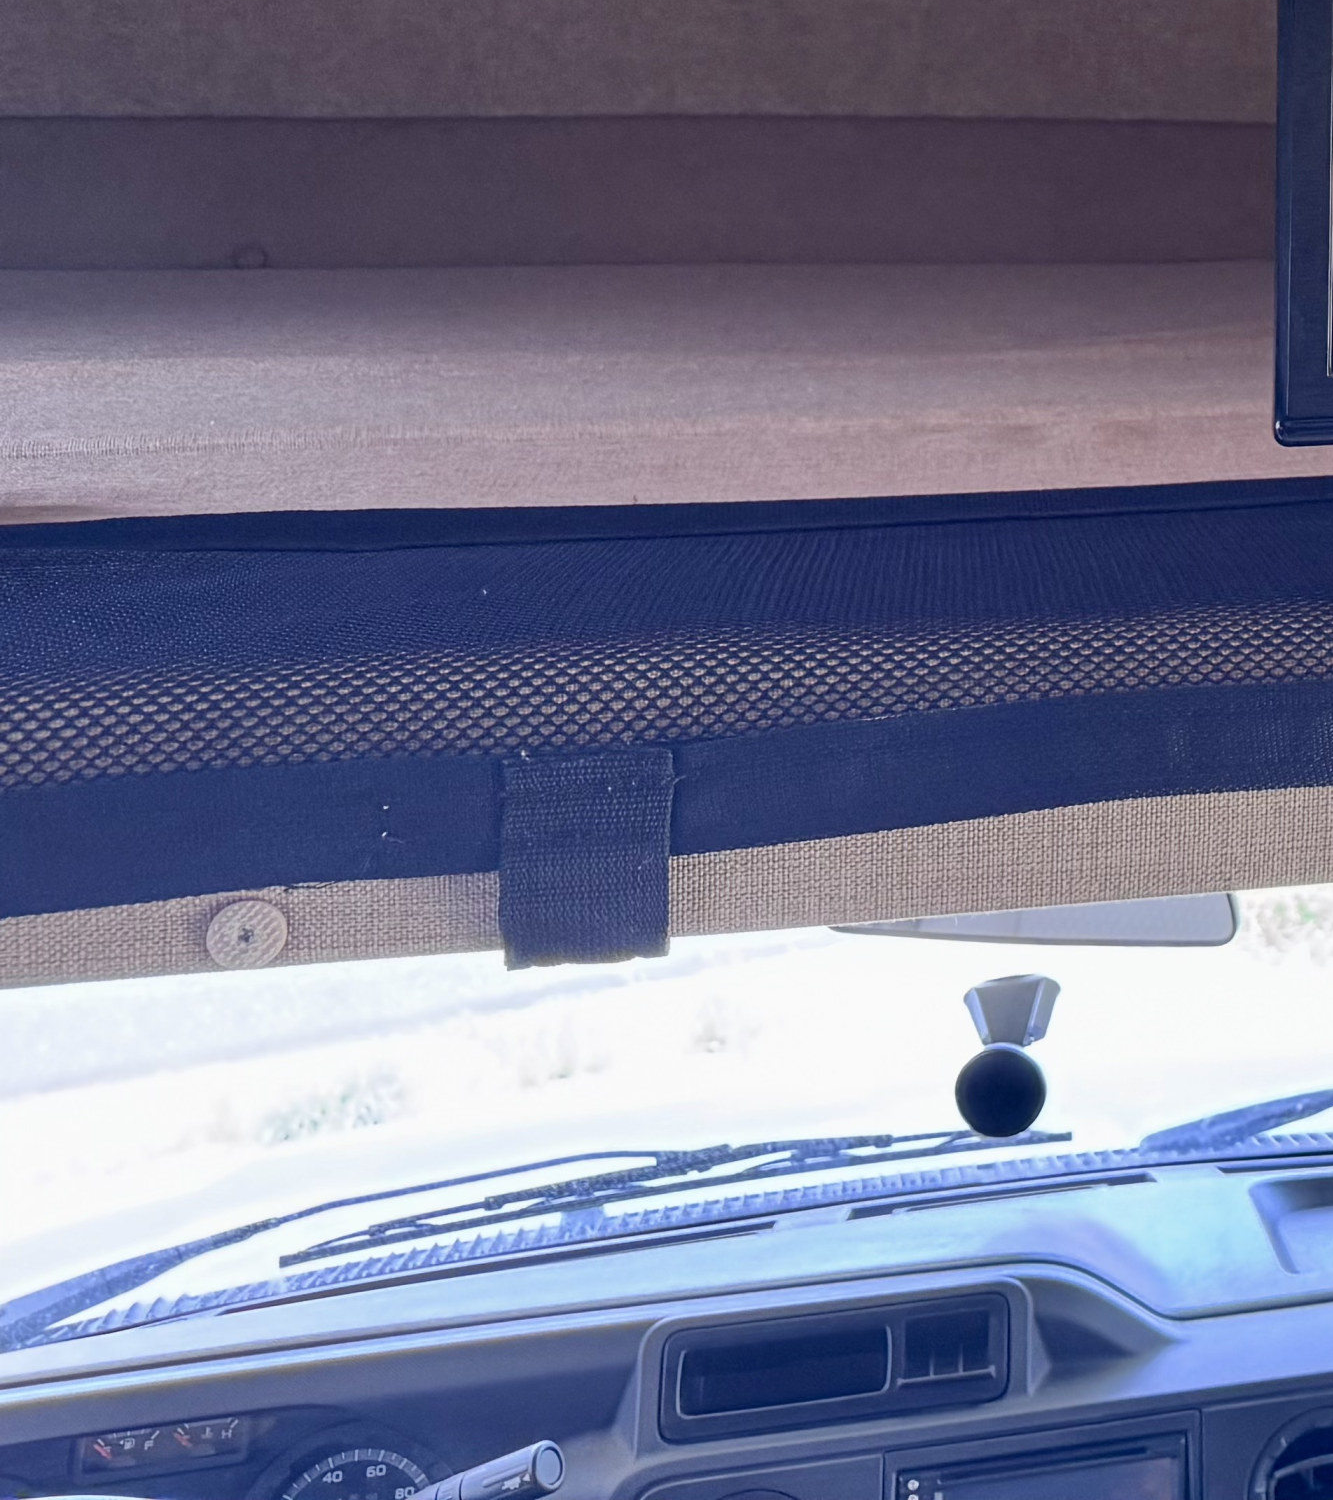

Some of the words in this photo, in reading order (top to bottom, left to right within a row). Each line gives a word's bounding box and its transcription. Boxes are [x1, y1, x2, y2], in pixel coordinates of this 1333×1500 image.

[221, 1429, 233, 1439] H
[322, 1470, 343, 1483] 40
[366, 1464, 387, 1478] 60
[394, 1486, 415, 1500] 80
